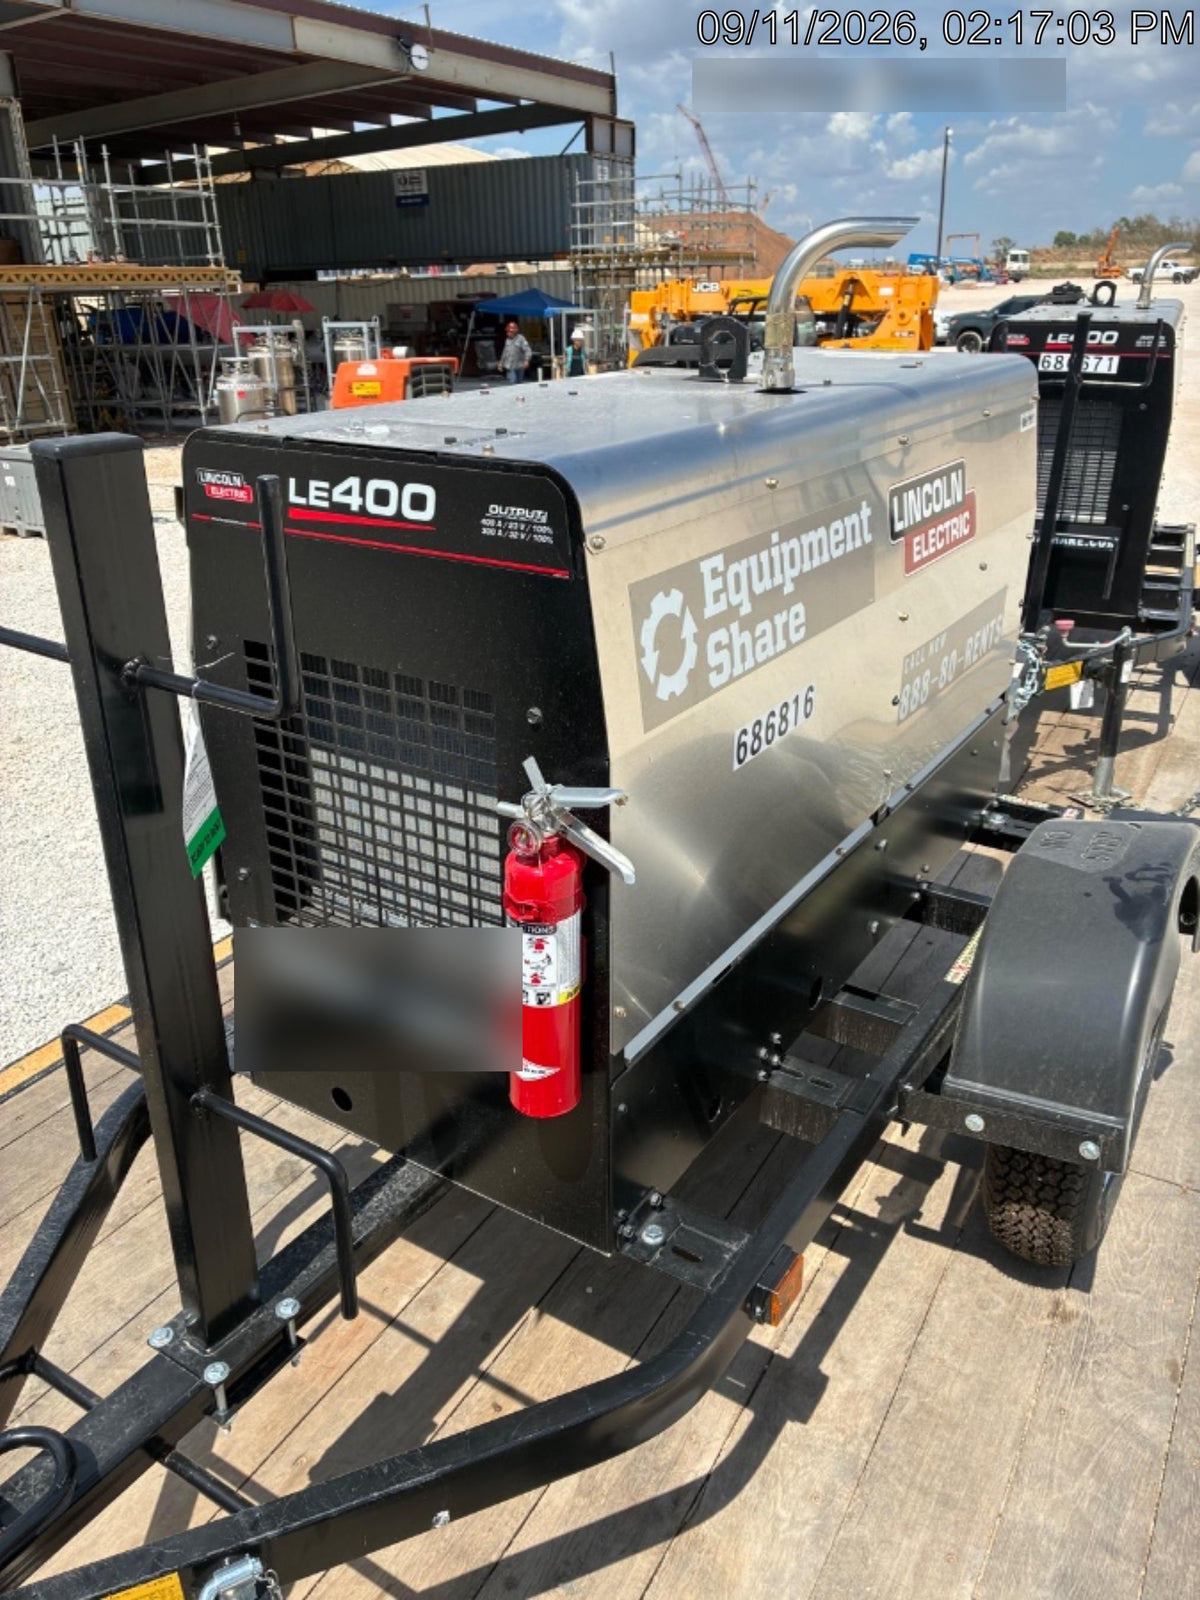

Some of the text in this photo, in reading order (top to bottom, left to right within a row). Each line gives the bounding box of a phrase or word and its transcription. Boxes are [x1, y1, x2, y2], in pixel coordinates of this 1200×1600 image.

[691, 282, 719, 293] JCB
[1046, 330, 1119, 344] LE00
[200, 470, 242, 487] LINCOLN
[210, 486, 249, 500] ELECTRIC
[288, 476, 436, 522] LE400
[893, 469, 963, 532] LINCOLN
[700, 500, 872, 619] Equipment
[912, 511, 970, 563] ELECTRIC
[706, 602, 806, 689] Share
[736, 685, 815, 766] 686816
